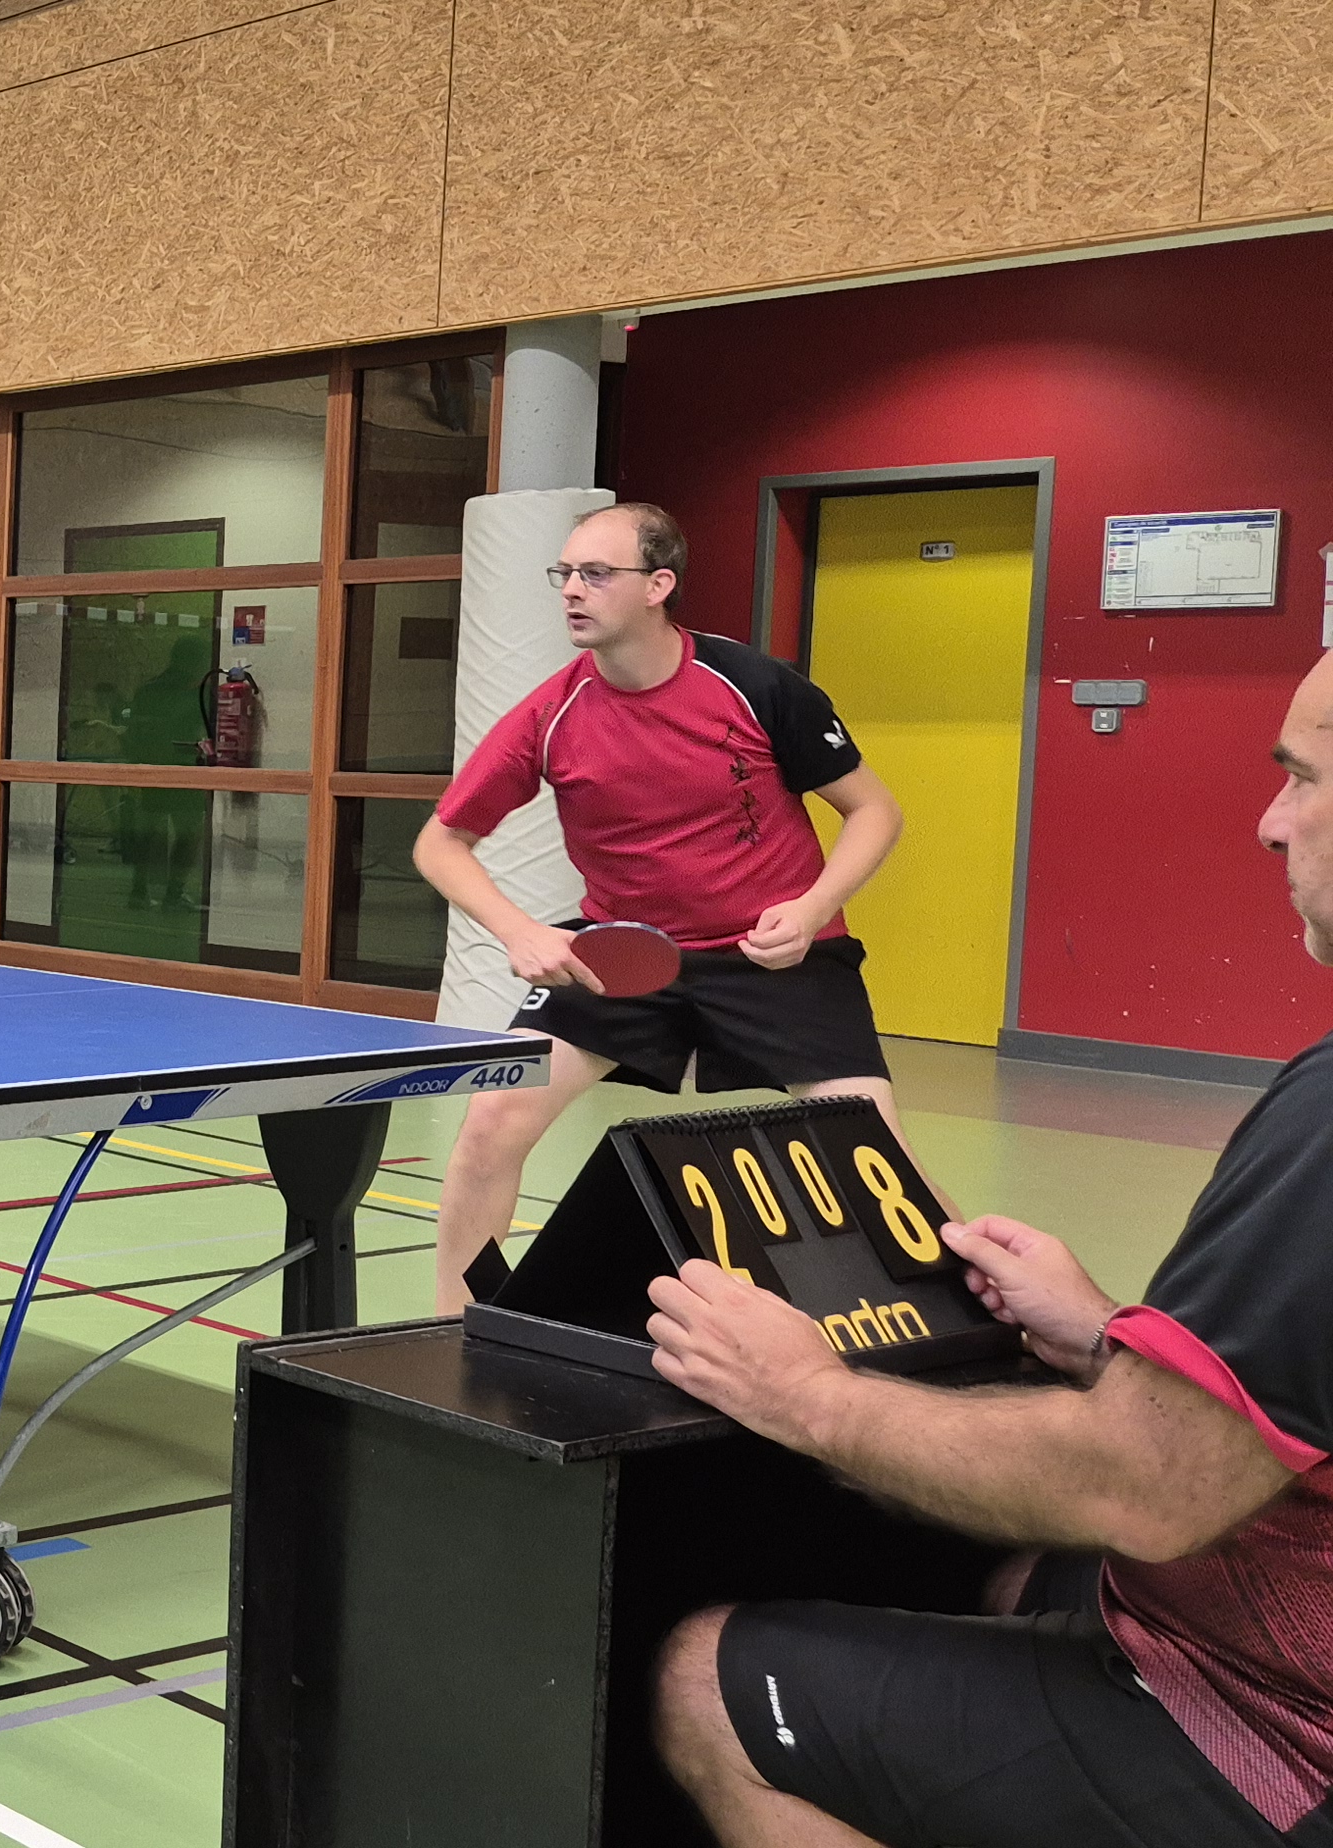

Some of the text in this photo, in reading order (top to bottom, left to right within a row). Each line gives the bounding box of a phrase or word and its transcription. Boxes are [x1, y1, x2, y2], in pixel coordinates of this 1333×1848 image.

[943, 545, 949, 554] 1
[398, 1064, 524, 1095] INDOOR 440
[682, 1140, 941, 1285] 2 0 0 8
[813, 1297, 931, 1352] ndro
[765, 1673, 785, 1726] ARTENGO
